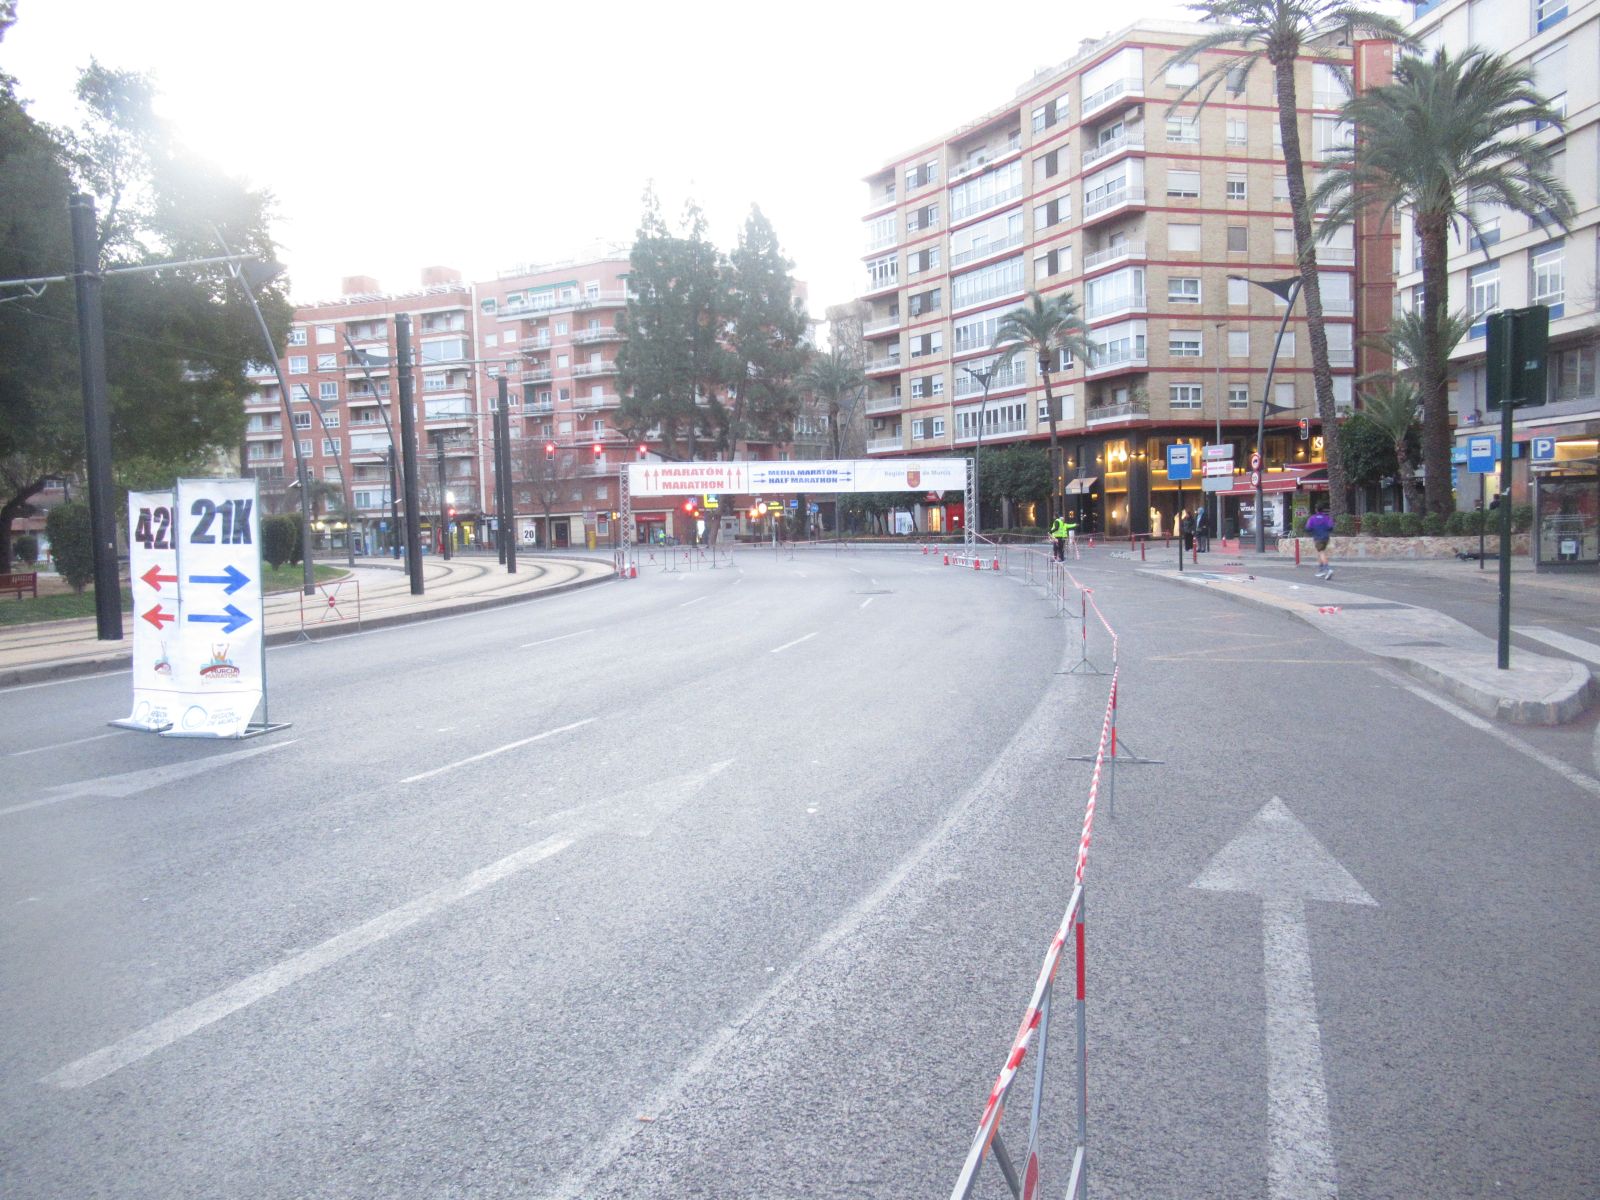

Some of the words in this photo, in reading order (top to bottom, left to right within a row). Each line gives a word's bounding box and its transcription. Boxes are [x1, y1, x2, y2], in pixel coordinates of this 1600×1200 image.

[1537, 440, 1551, 457] P
[662, 481, 724, 490] MARATHON
[135, 506, 176, 549] 42
[190, 498, 253, 544] 21K
[524, 529, 534, 539] 20
